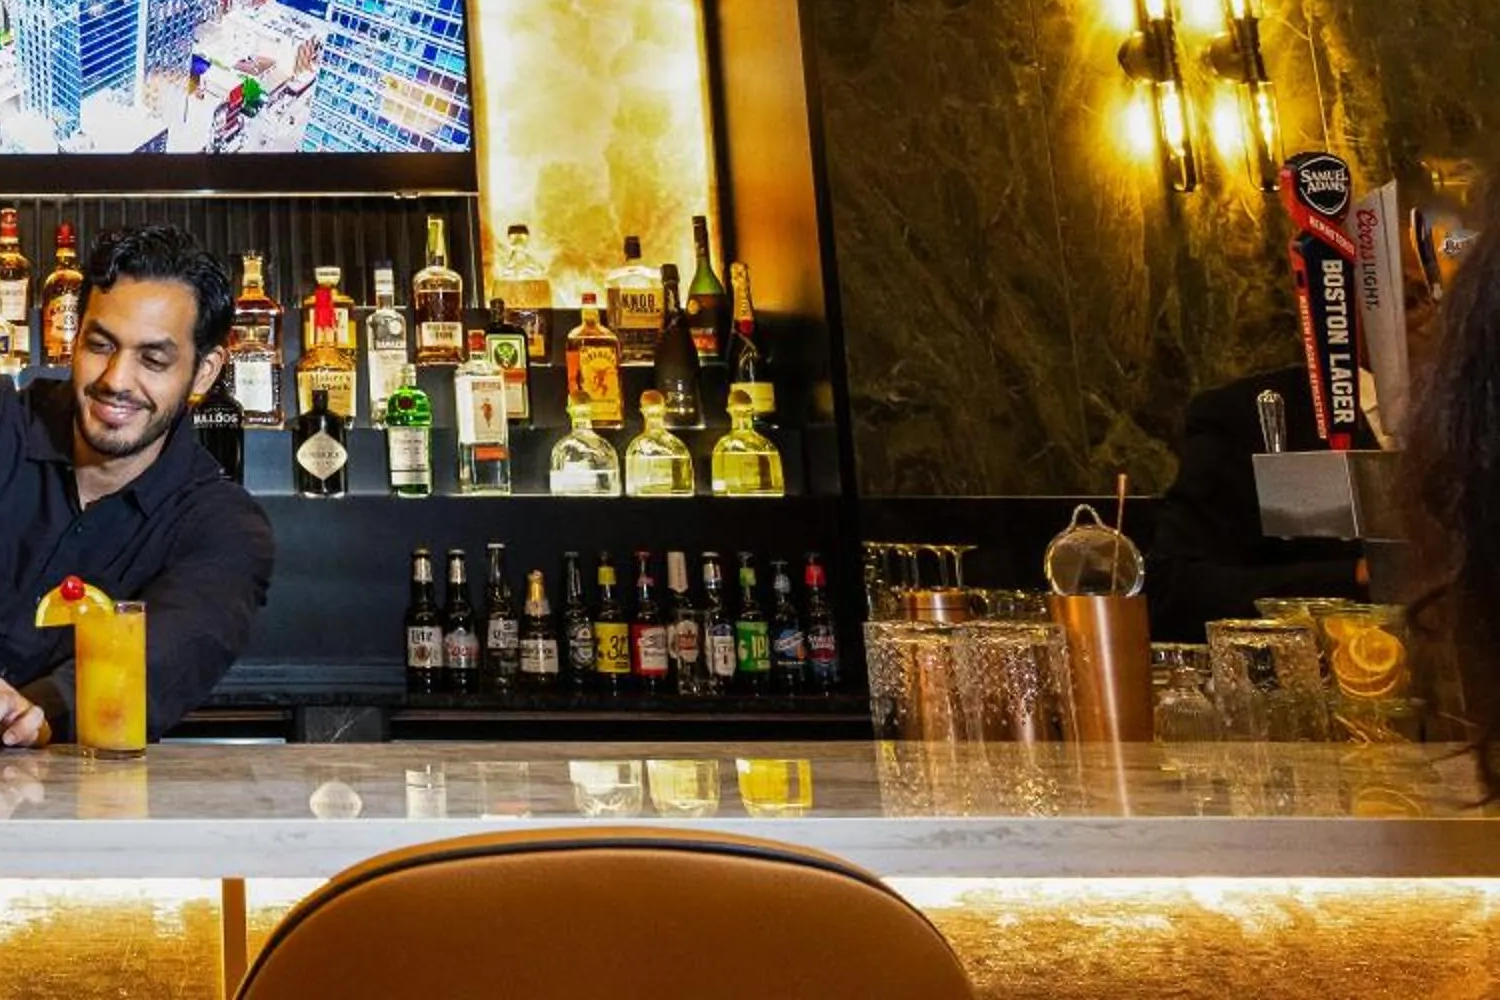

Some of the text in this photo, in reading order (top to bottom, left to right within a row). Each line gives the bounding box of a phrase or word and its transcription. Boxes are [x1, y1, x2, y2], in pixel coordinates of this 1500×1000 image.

[1300, 167, 1349, 183] SAMUEL
[1307, 181, 1346, 194] ADAMS
[1321, 259, 1349, 345] BOSTON
[1328, 353, 1355, 425] LAGER
